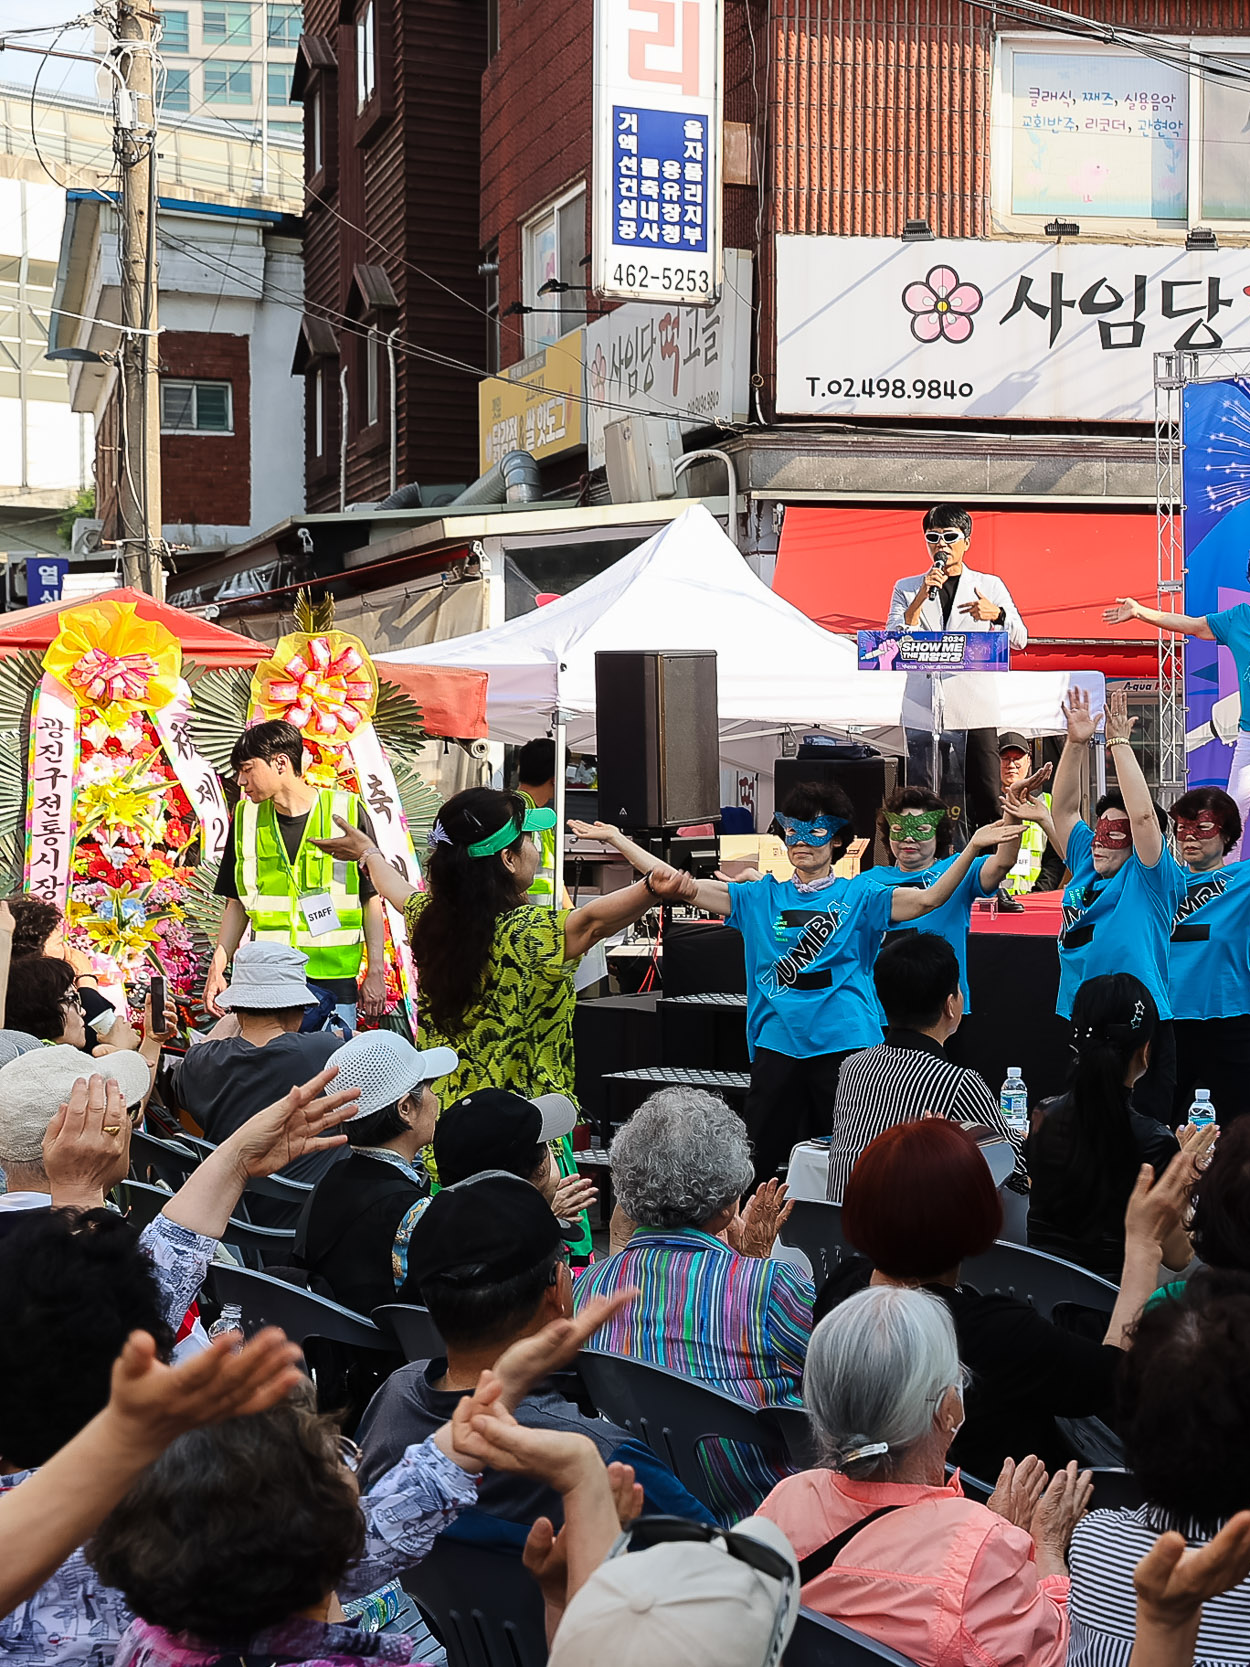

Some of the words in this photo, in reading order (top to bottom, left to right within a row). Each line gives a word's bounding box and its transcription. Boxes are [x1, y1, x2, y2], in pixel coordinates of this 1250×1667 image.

[628, 0, 699, 96] 리
[1029, 87, 1076, 108] 클래식,
[1124, 92, 1176, 112] 실용음악
[1022, 114, 1078, 133] 교회반주,
[1085, 118, 1132, 133] 리코더,
[1138, 118, 1183, 137] 관현악
[613, 263, 709, 293] 462-5253
[806, 377, 973, 399] T.02.498.9840
[902, 643, 942, 651] SHOW
[942, 643, 964, 651] ME
[31, 717, 71, 900] 광진구전통시장
[308, 907, 332, 921] STAFF
[761, 899, 851, 999] ZUMBA
